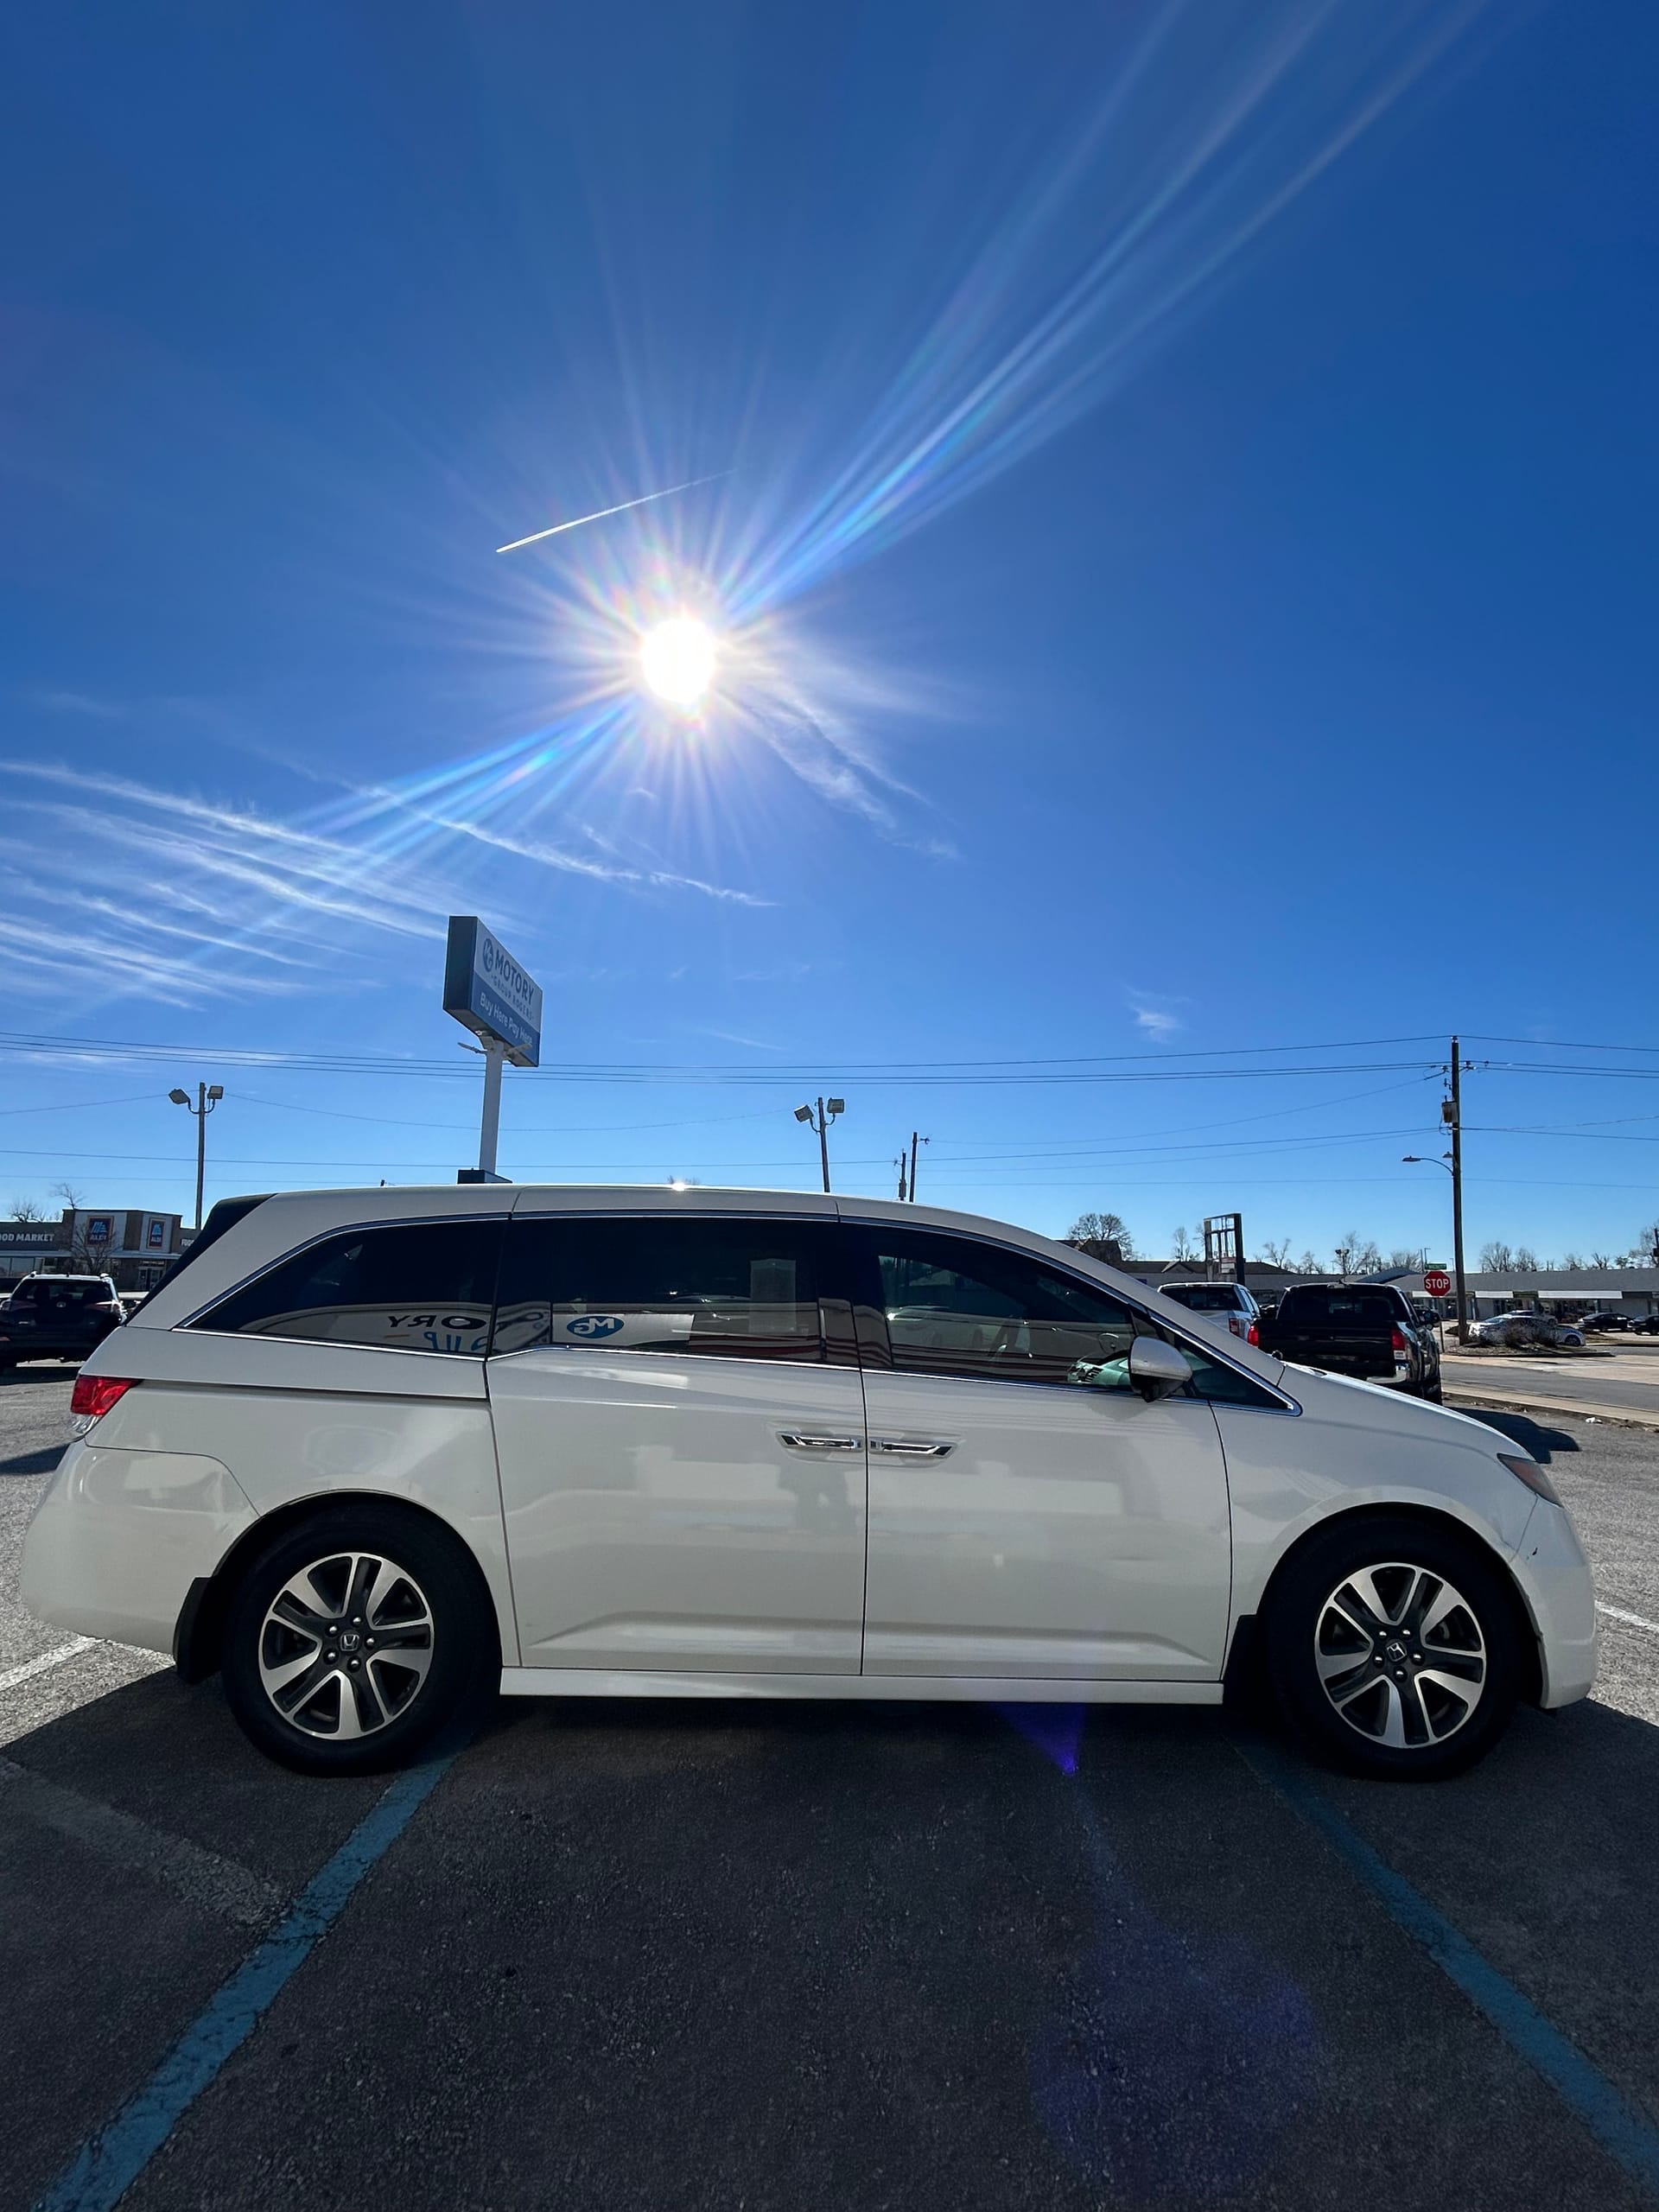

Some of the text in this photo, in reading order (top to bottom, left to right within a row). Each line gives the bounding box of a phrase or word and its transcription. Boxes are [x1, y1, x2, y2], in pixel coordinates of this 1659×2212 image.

[495, 949, 534, 1006] MOTORY
[480, 992, 493, 1016] Buy
[493, 1003, 508, 1027] Here
[508, 1017, 519, 1039] Pay
[0, 1233, 55, 1242] OD MARKET
[1426, 1278, 1449, 1288] STOP
